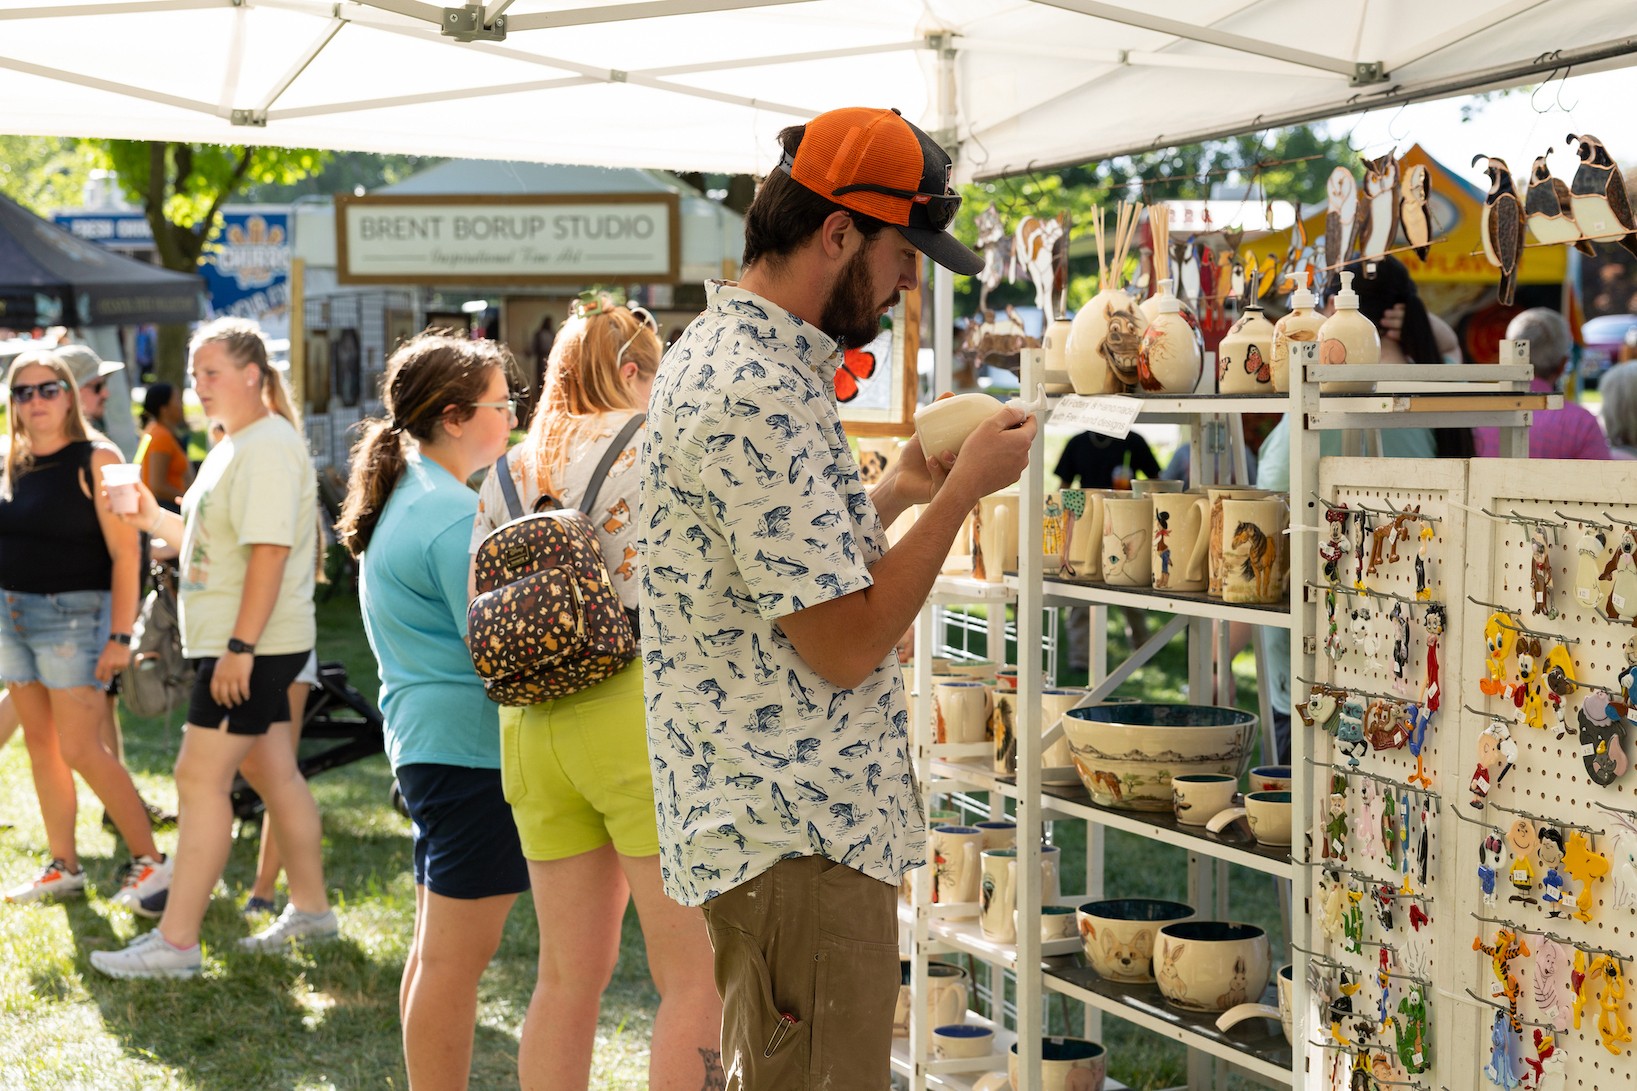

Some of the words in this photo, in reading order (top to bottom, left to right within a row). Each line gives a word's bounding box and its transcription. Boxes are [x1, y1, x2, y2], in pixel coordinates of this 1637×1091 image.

[360, 214, 444, 241] BRENT
[453, 214, 545, 240] BORUP
[552, 213, 655, 240] STUDIO
